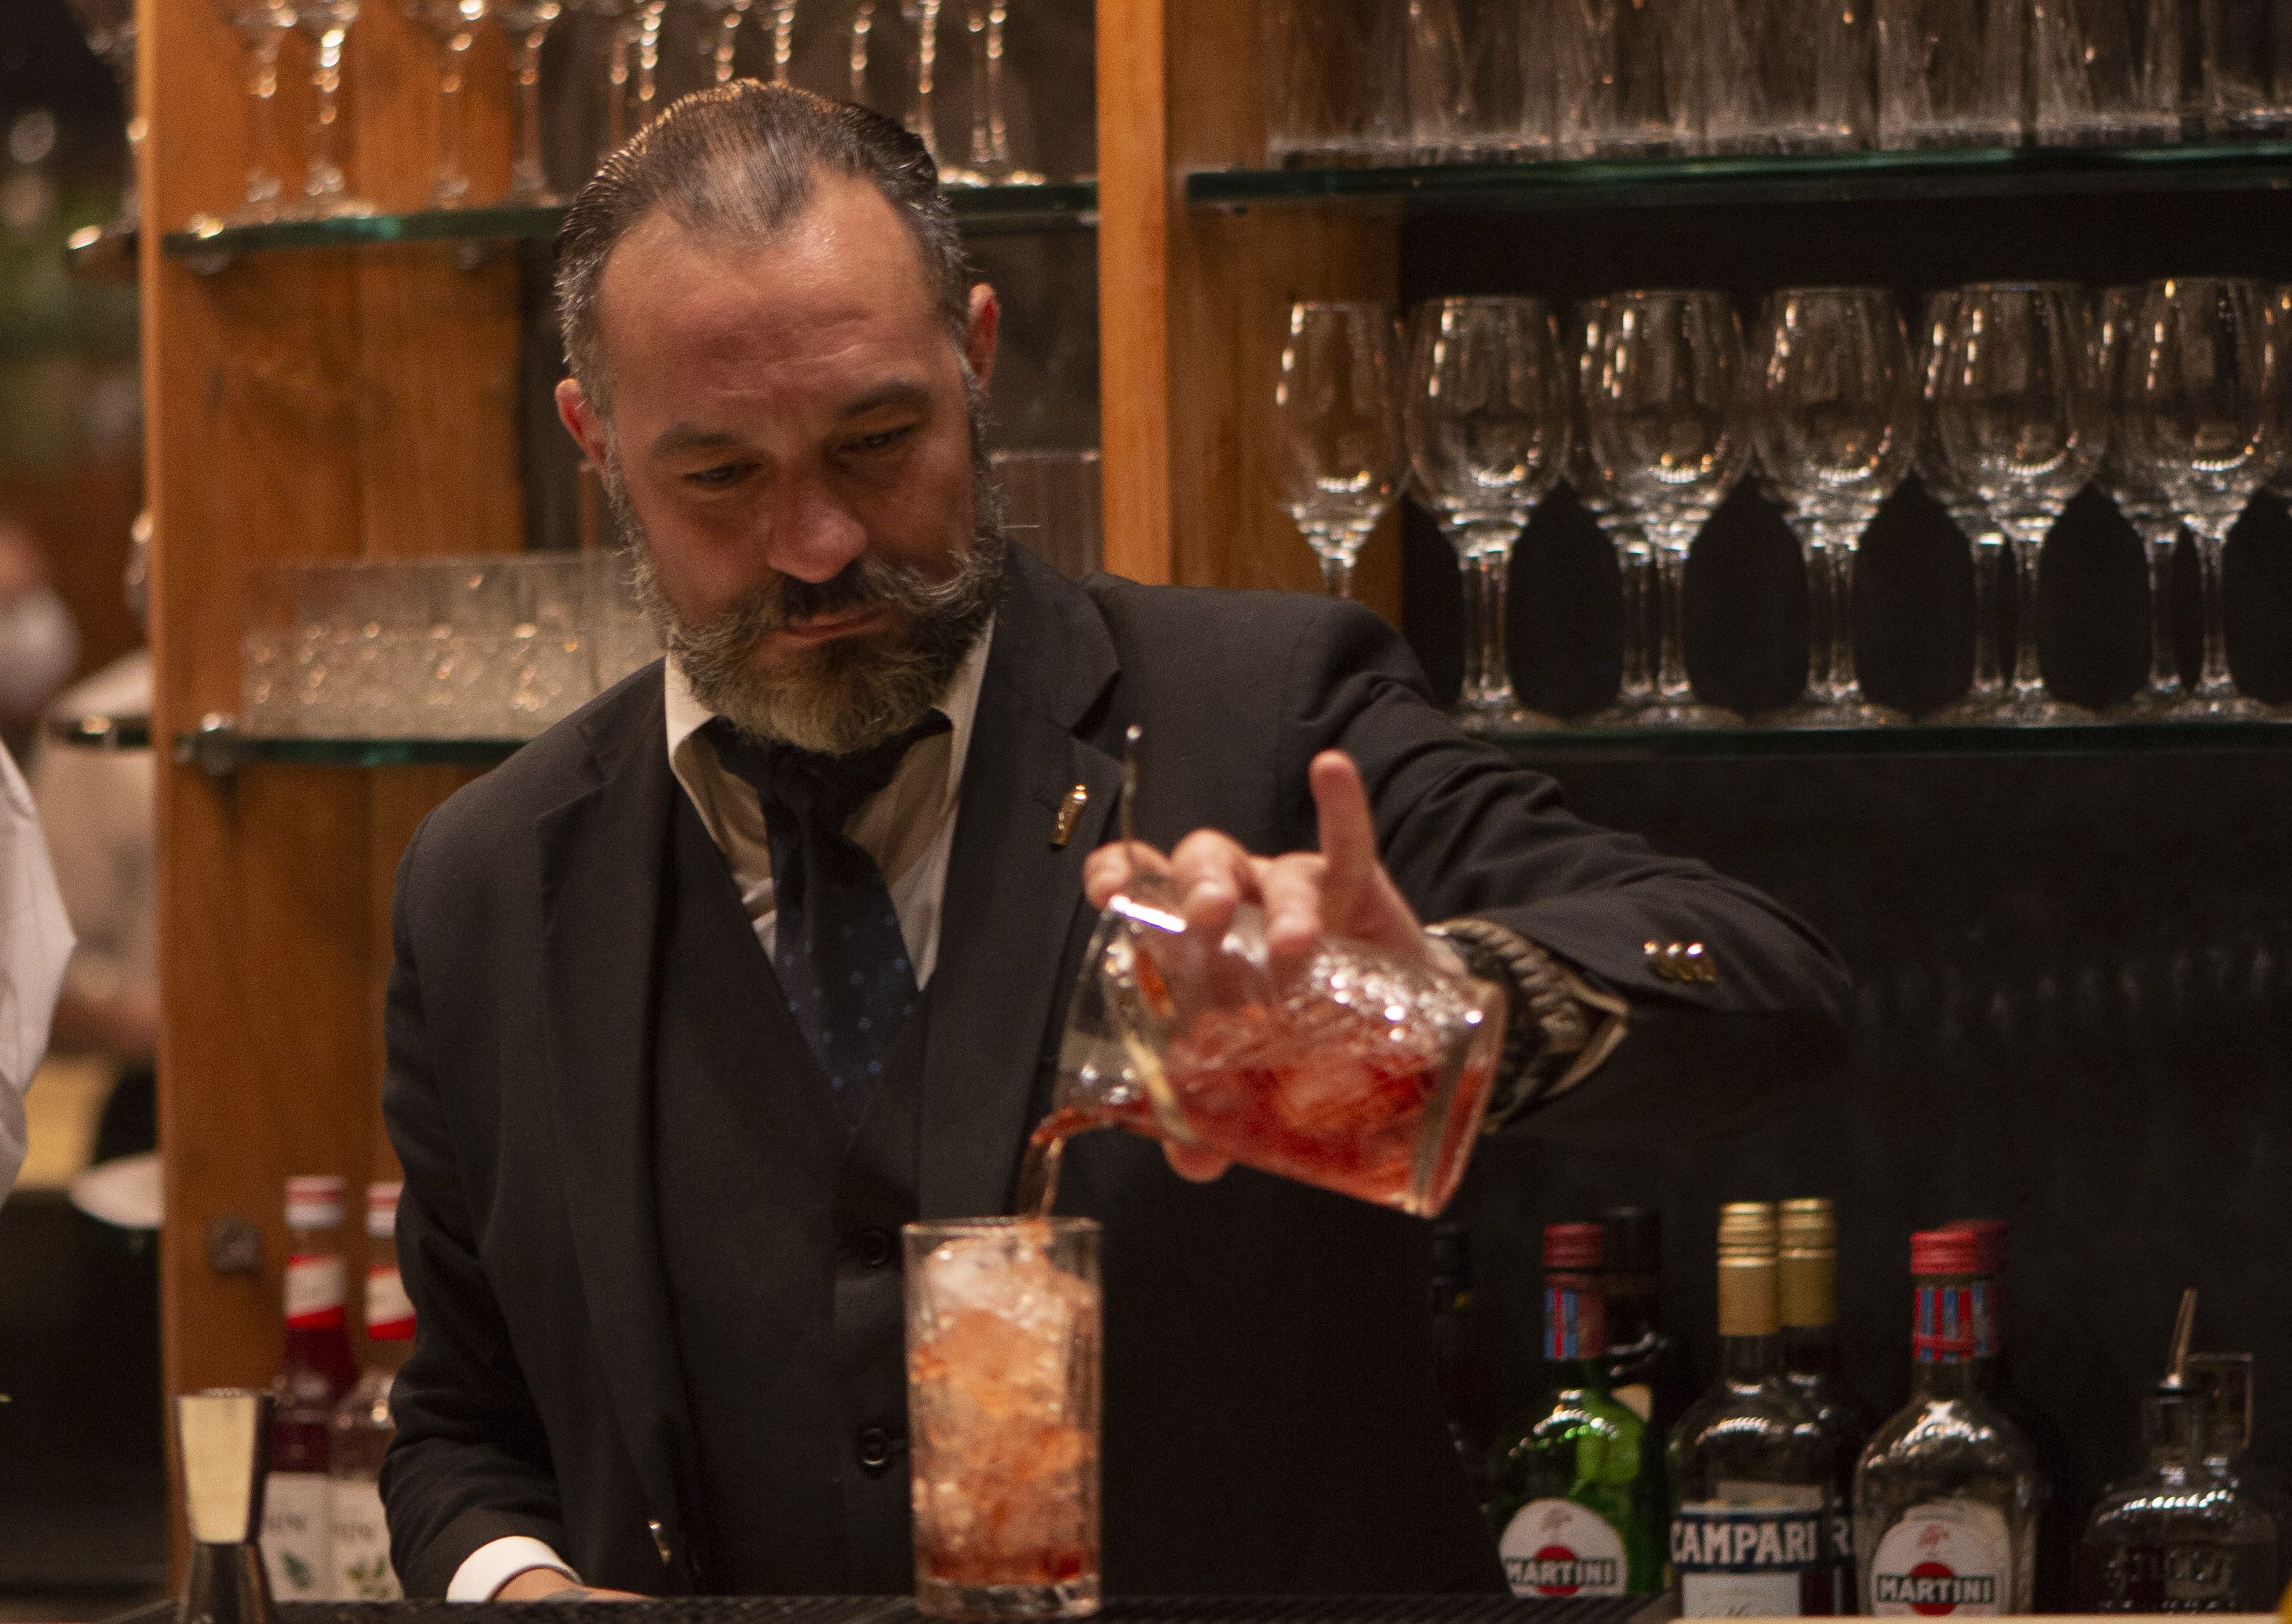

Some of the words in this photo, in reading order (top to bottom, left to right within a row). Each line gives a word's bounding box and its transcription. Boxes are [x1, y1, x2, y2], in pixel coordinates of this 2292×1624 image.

[1671, 1520, 1817, 1564] CAMPARI
[1506, 1560, 1613, 1585] MARTINI
[1879, 1577, 1992, 1600] MARTINI
